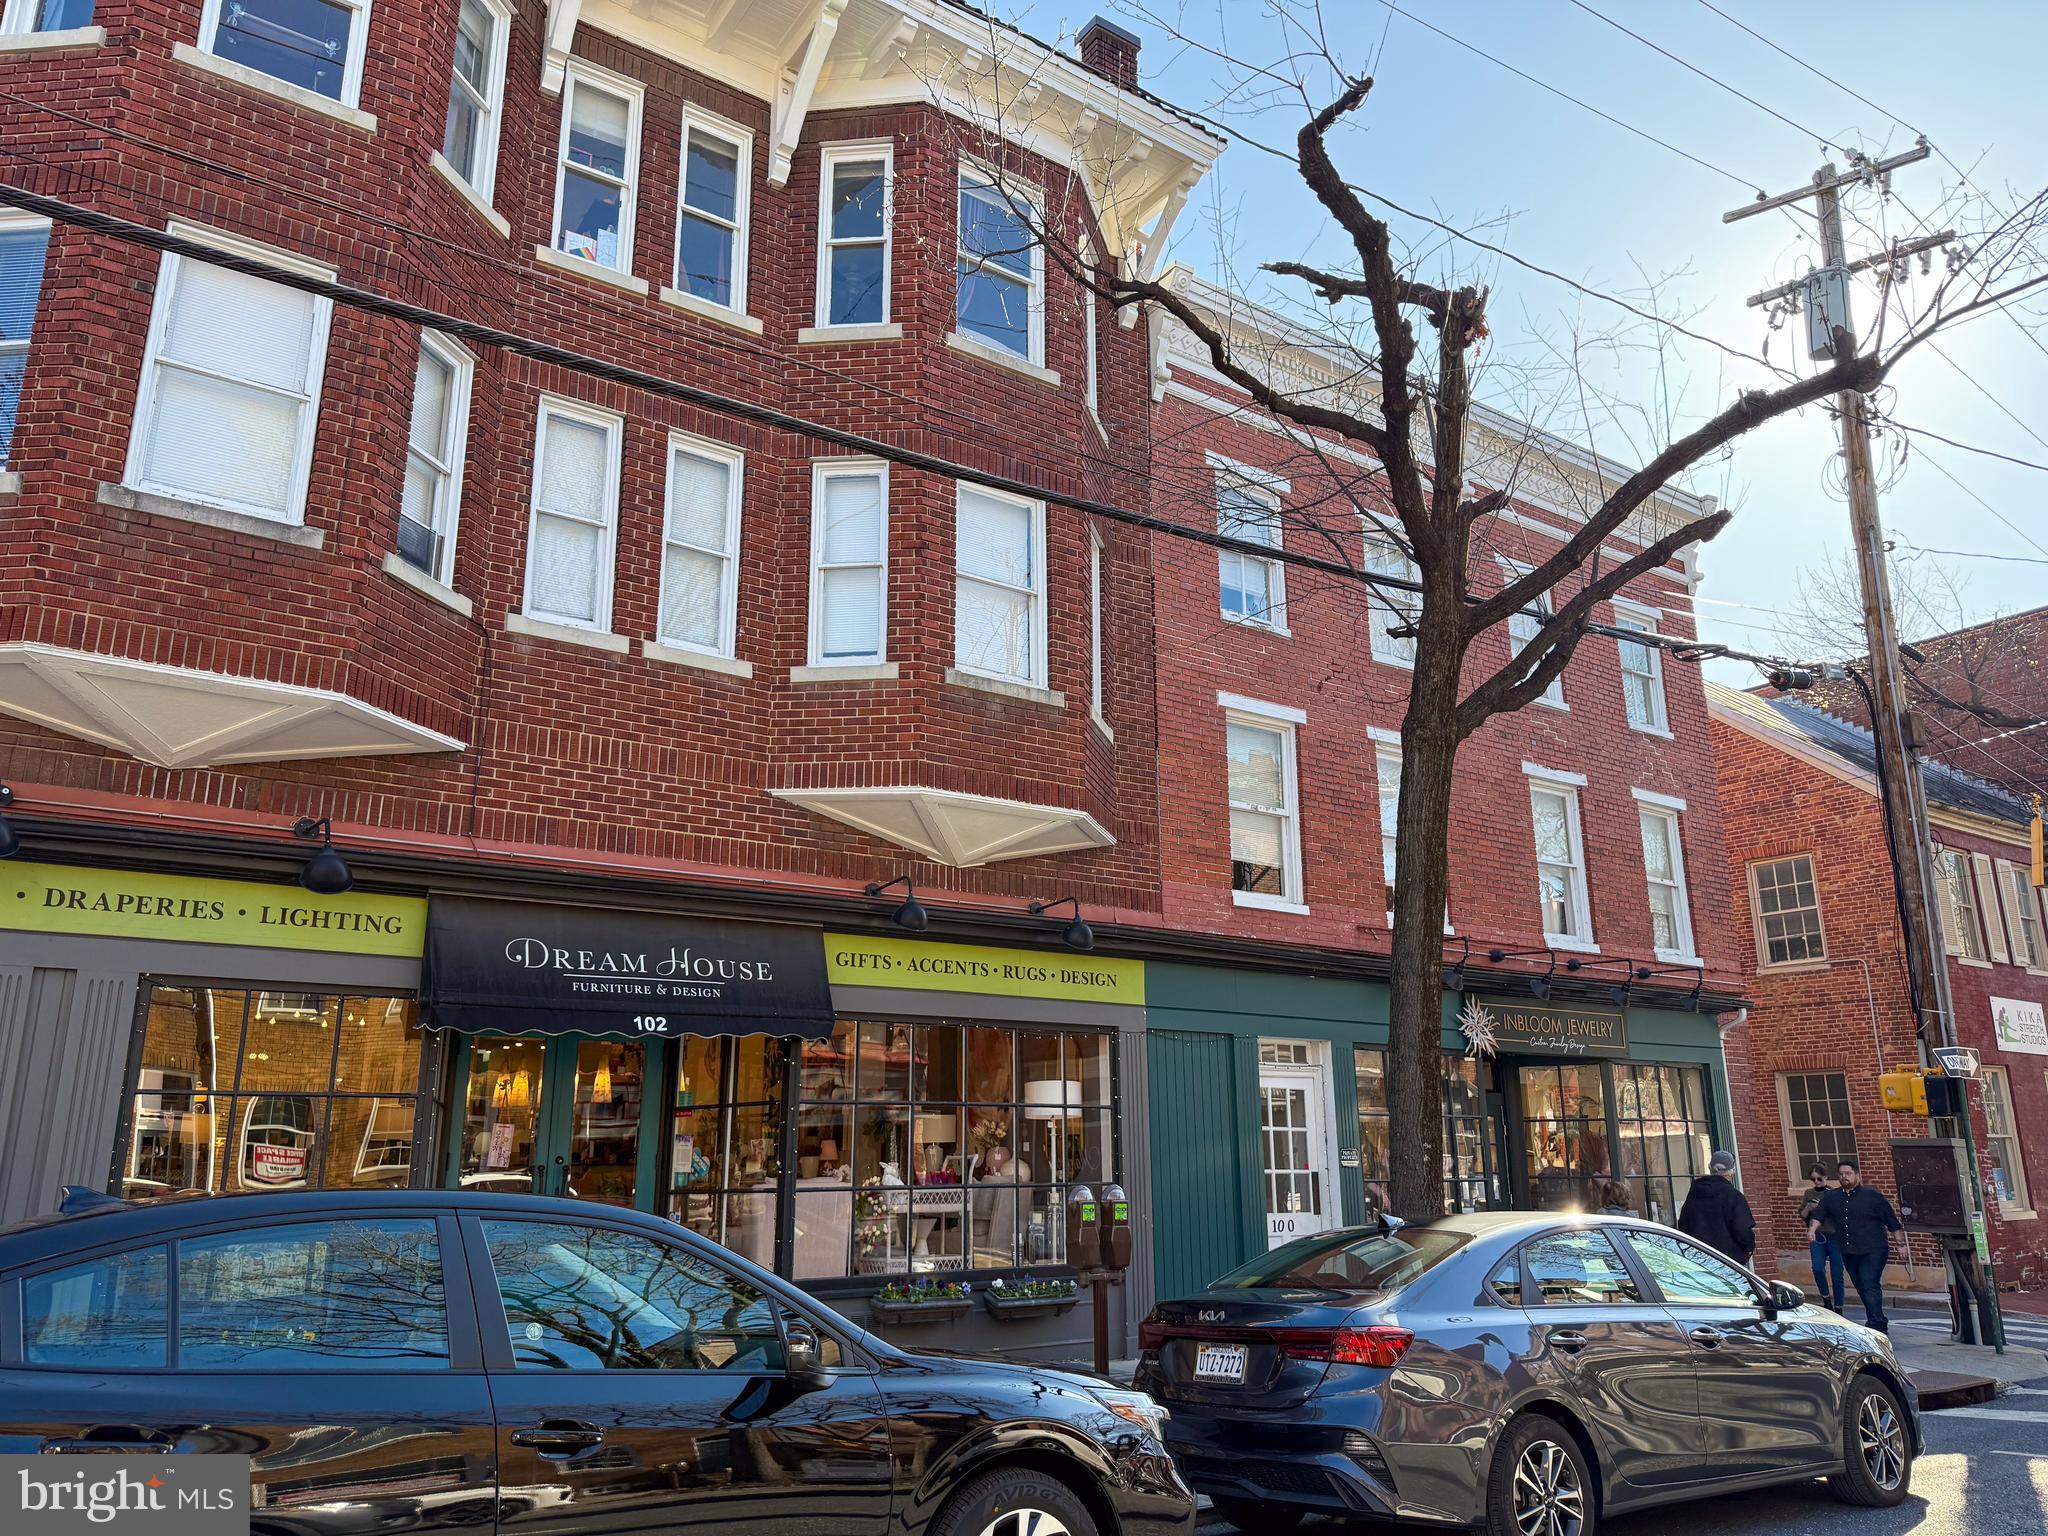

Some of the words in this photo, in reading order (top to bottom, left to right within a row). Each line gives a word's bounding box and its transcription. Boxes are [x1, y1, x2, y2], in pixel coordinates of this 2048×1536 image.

[43, 887, 225, 921] DRAPERIES
[259, 905, 403, 935] LIGHTING
[505, 937, 649, 973] DREAM
[656, 947, 774, 981] HOUSE
[835, 951, 892, 970] GIFTS
[906, 956, 990, 978] ACCENTS
[1003, 965, 1048, 982] RUGS
[1060, 969, 1118, 988] DESIGN
[572, 981, 652, 995] FURNITURE
[656, 983, 668, 995] &
[672, 986, 722, 998] DESIGN
[633, 1015, 668, 1032] 102
[1503, 1013, 1563, 1034] INBLOOM
[1566, 1018, 1614, 1038] JEWELRY
[2016, 1010, 2043, 1024] KIKA
[2019, 1023, 2045, 1035] STRETCH
[2020, 1035, 2047, 1046] STUDIOS
